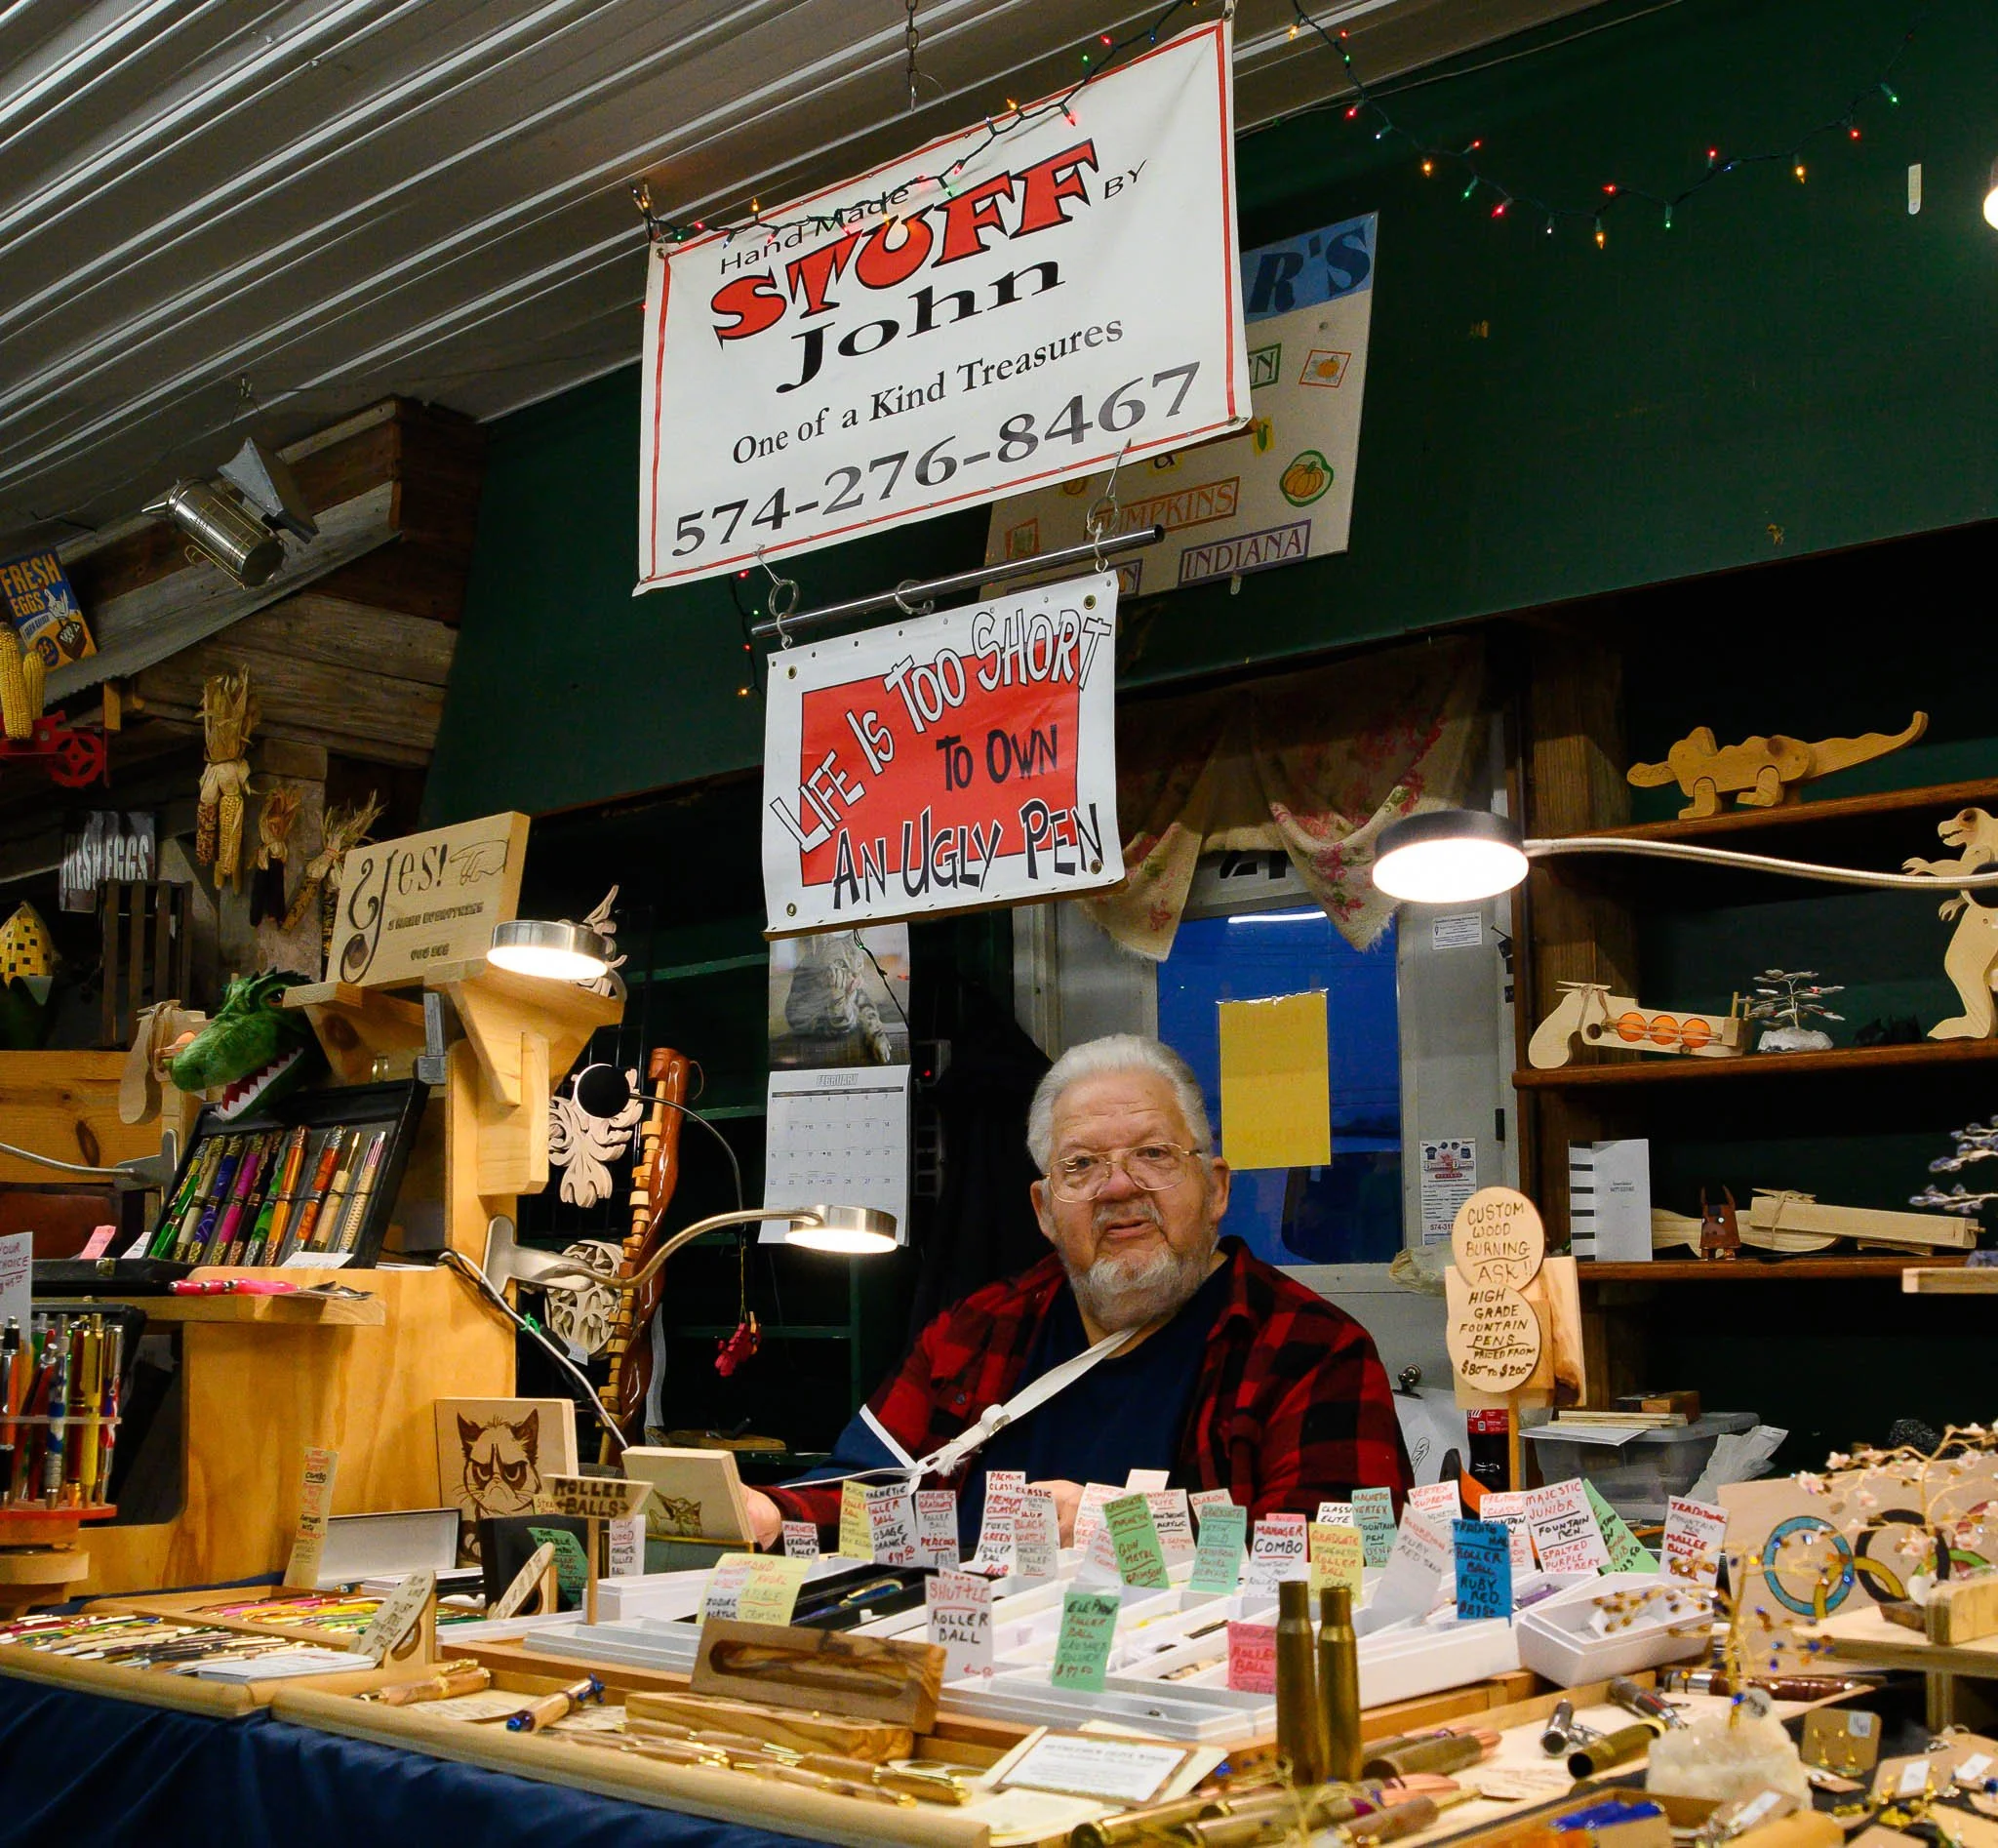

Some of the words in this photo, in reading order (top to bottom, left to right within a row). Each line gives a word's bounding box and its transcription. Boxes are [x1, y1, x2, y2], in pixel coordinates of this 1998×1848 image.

[720, 224, 804, 275] Hand
[815, 186, 909, 236] Made
[710, 139, 1099, 348] STUFF
[1104, 160, 1147, 200] BY
[777, 261, 1065, 393] John
[734, 430, 789, 465] One
[798, 407, 829, 442] of
[842, 410, 859, 428] a
[870, 372, 944, 422] Kind
[956, 320, 1124, 391] Treasures
[672, 361, 1201, 556] 574-276-8467
[1182, 527, 1303, 581] INDIANA
[0, 553, 62, 597] FRESH
[10, 591, 46, 618] EGGS
[770, 749, 865, 854] LIFE
[846, 709, 895, 776] IS
[884, 648, 966, 734] TOO
[972, 608, 1112, 691] SHORT
[936, 735, 973, 791] TO
[985, 724, 1058, 783] OWN
[832, 827, 887, 910] AN
[901, 805, 1003, 897] UGLY
[1019, 798, 1104, 879] PEN
[340, 843, 448, 984] Yes!
[1467, 1202, 1524, 1225] CUSTOM
[1472, 1223, 1511, 1238] WOOD
[1466, 1241, 1530, 1257] BURNING
[1468, 1288, 1506, 1305] HIGH
[1474, 1305, 1519, 1319] GRADE
[1459, 1319, 1529, 1334] FOUNTAIN
[1473, 1335, 1515, 1347] PENS
[554, 1478, 626, 1498] ROLLER
[1016, 1486, 1052, 1498] CLASSIC
[1412, 1484, 1450, 1498] VERTEX
[1526, 1482, 1581, 1506] MAJESTIC
[565, 1498, 619, 1517] BALLS
[1415, 1496, 1454, 1508] SUPREME
[1529, 1500, 1576, 1520] JUNIOR
[873, 1515, 895, 1526] BALL
[1538, 1515, 1589, 1536] FOUNTAIN
[874, 1522, 904, 1540] OSAGE
[983, 1532, 1012, 1543] GREEN
[1256, 1525, 1303, 1538] MANAGER
[1255, 1539, 1303, 1553] COMBO
[1542, 1540, 1587, 1560] SPALTED
[1666, 1533, 1707, 1550] MALLEE
[1457, 1547, 1502, 1564] ROLLER
[1545, 1554, 1584, 1570] PURPLE
[1460, 1575, 1497, 1590] RUBY
[929, 1582, 988, 1603] SHUTTLE
[932, 1611, 988, 1627] ROLLER
[939, 1627, 980, 1644] BALL
